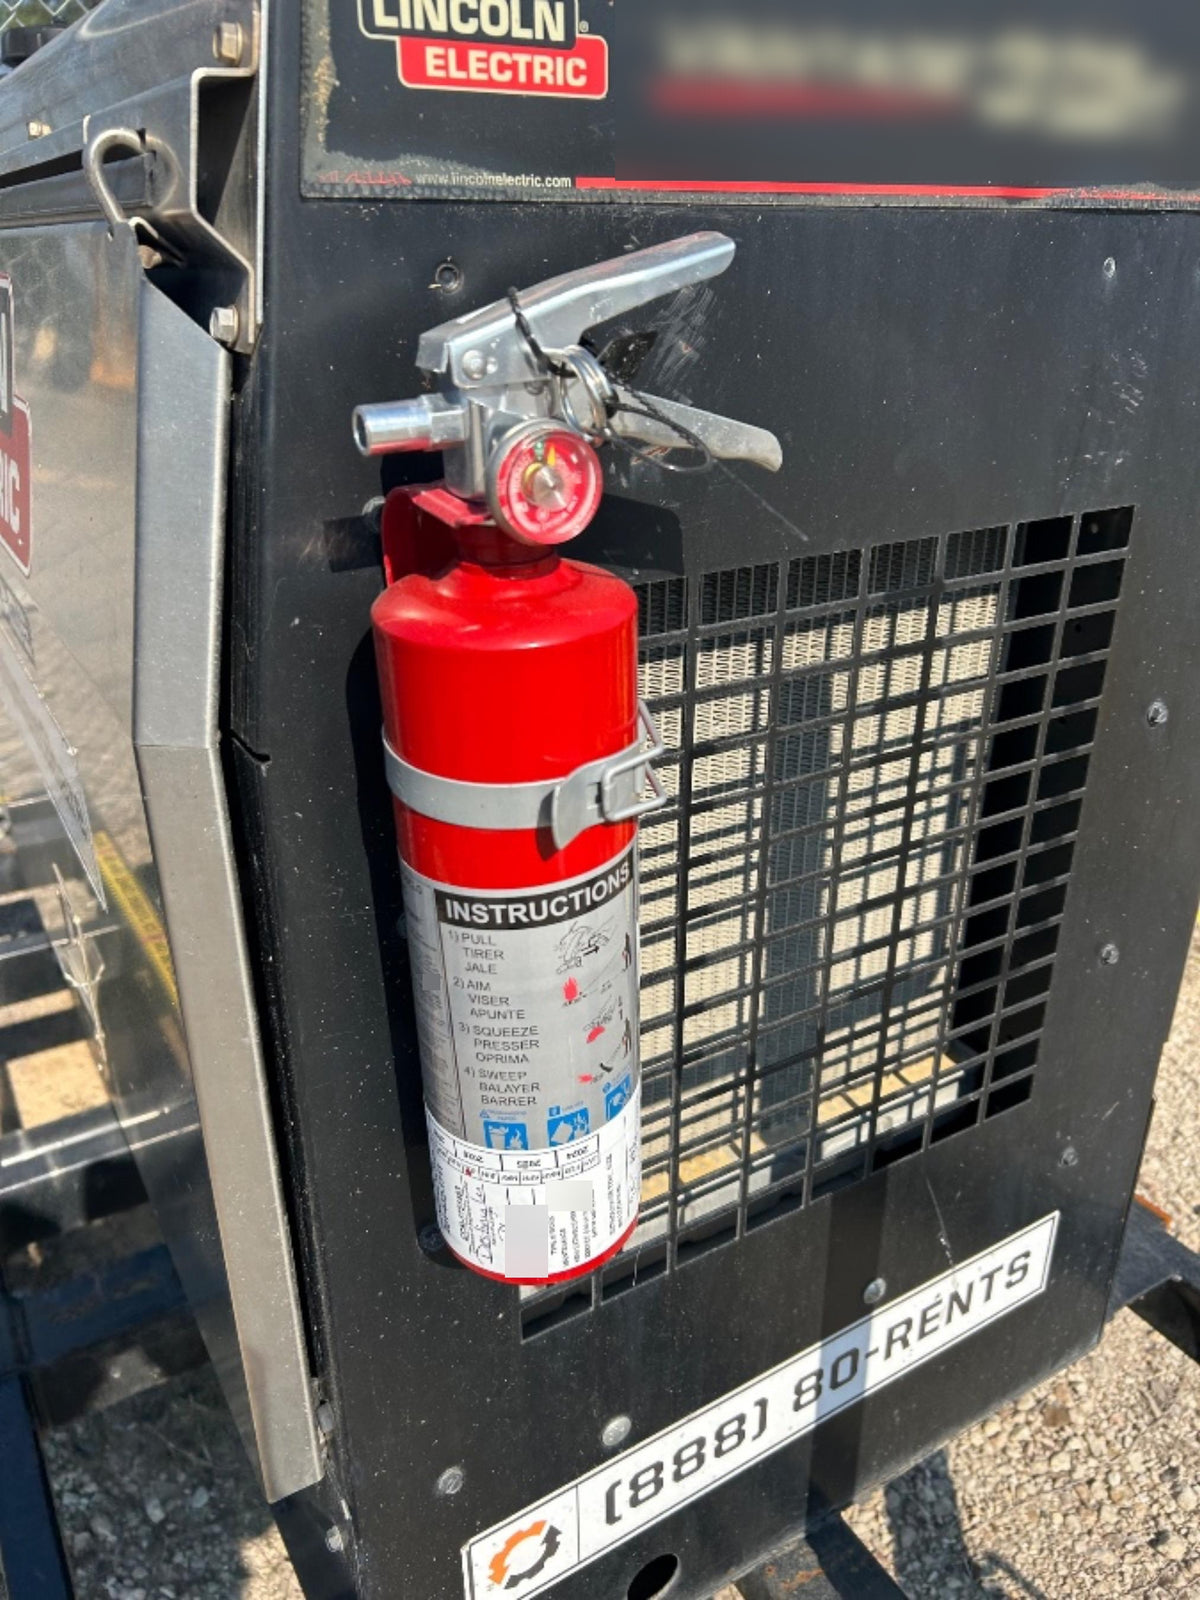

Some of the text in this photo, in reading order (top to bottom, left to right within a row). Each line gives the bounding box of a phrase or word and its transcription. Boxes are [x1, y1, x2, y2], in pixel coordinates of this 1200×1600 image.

[373, 0, 566, 42] LINCOLN
[425, 46, 588, 87] ELECTRIC
[416, 172, 572, 188] www.lincolnelectric.com
[445, 862, 630, 925] INSTRUCTIONS
[461, 932, 497, 946] PULL
[462, 946, 505, 960] TIRER
[464, 961, 498, 975] JALE
[467, 979, 491, 991] AIM
[468, 993, 510, 1006] VISER
[470, 1007, 526, 1020] APUNTE
[473, 1025, 540, 1037] SQUEEZE
[474, 1038, 540, 1051] PRESSER
[476, 1052, 529, 1064] OPRIMA
[478, 1068, 527, 1081] SWEEP
[479, 1082, 540, 1094] BALAYER
[481, 1094, 537, 1107] BARRER
[604, 1249, 1033, 1527] (888) 80-RENTS
